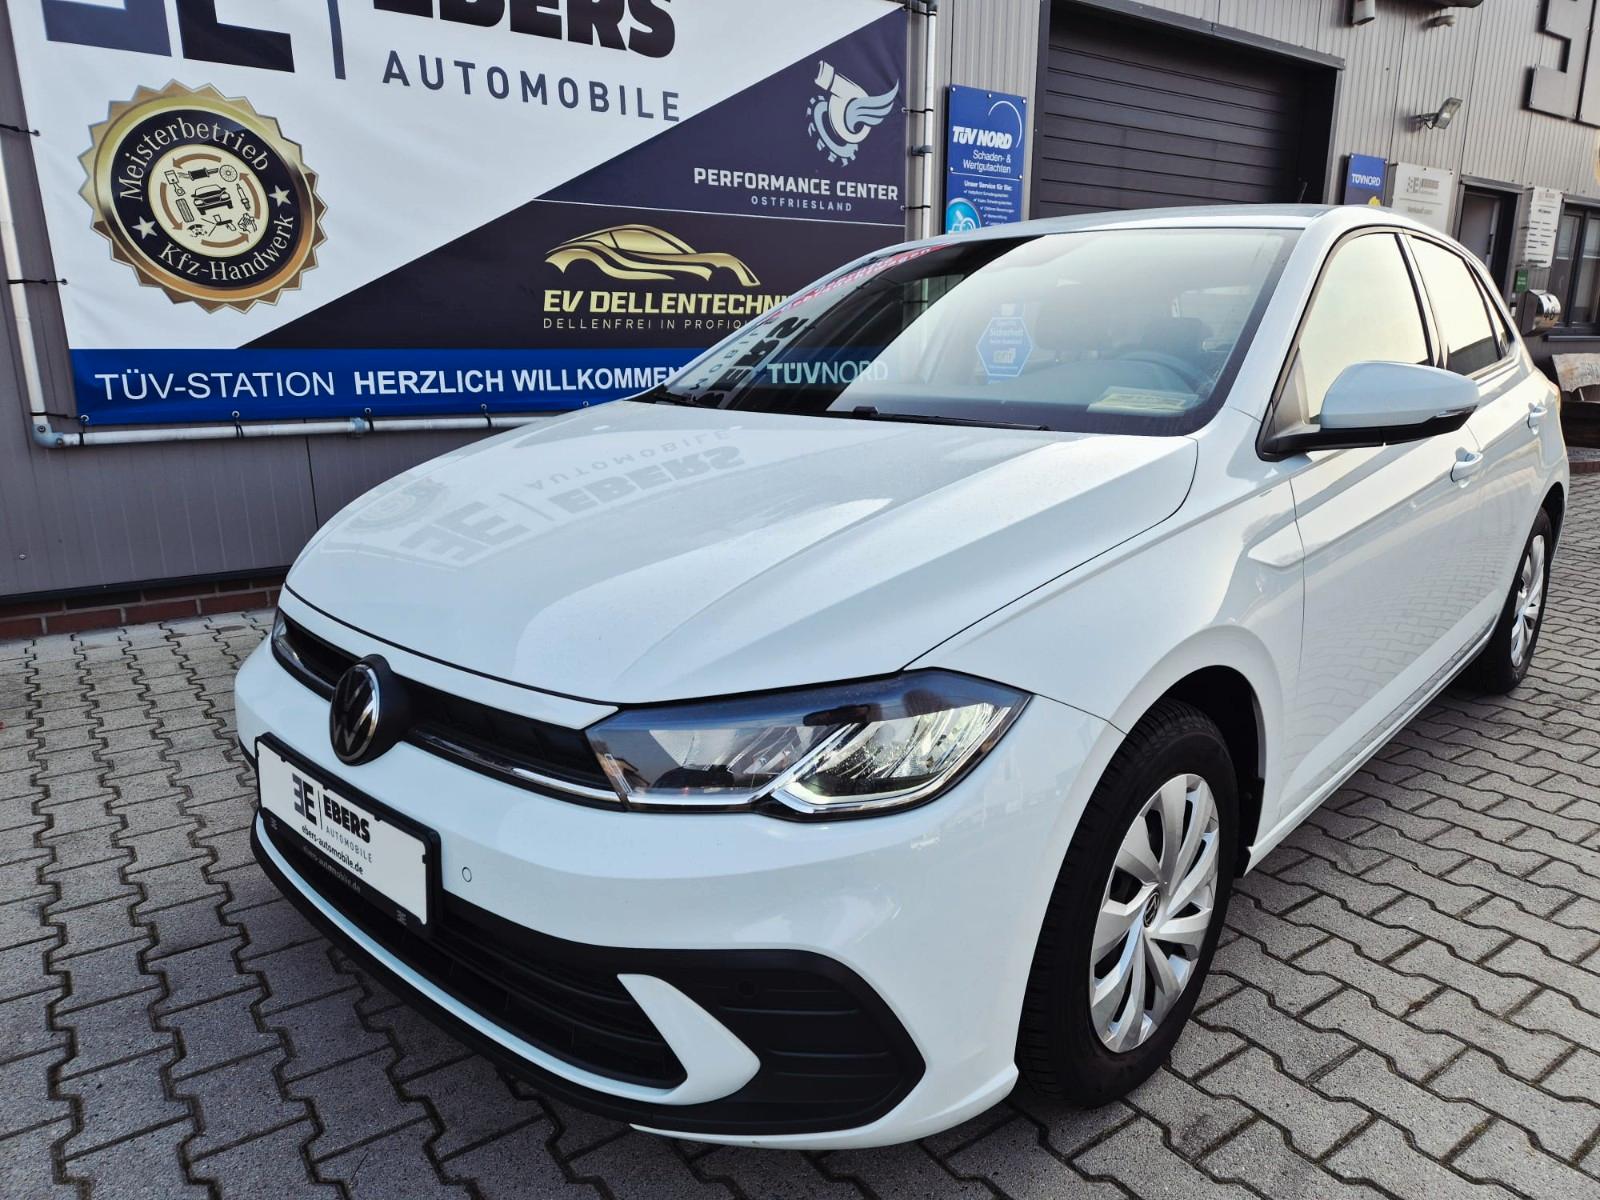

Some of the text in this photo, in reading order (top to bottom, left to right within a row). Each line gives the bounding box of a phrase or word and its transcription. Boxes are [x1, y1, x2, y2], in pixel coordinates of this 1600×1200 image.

[382, 50, 680, 123] AUTOMOBILE
[952, 126, 1013, 150] TÜV NORD
[118, 117, 269, 201] Meisterbetrieb
[693, 168, 899, 202] PERFORMANCE CENTER
[751, 195, 852, 213] OSTFRIESLAND
[158, 213, 294, 281] Kfz-Handwerk
[543, 290, 584, 313] EV
[543, 318, 747, 330] DELLENFREI IN PROFIQ
[95, 371, 334, 402] TÜV-STATION
[354, 370, 503, 396] HERZLICH
[766, 359, 888, 385] TÜVNORD
[323, 794, 371, 844] EBERS
[301, 825, 364, 875] ebers-automobile.de
[326, 825, 373, 863] AUTOMOBILE
